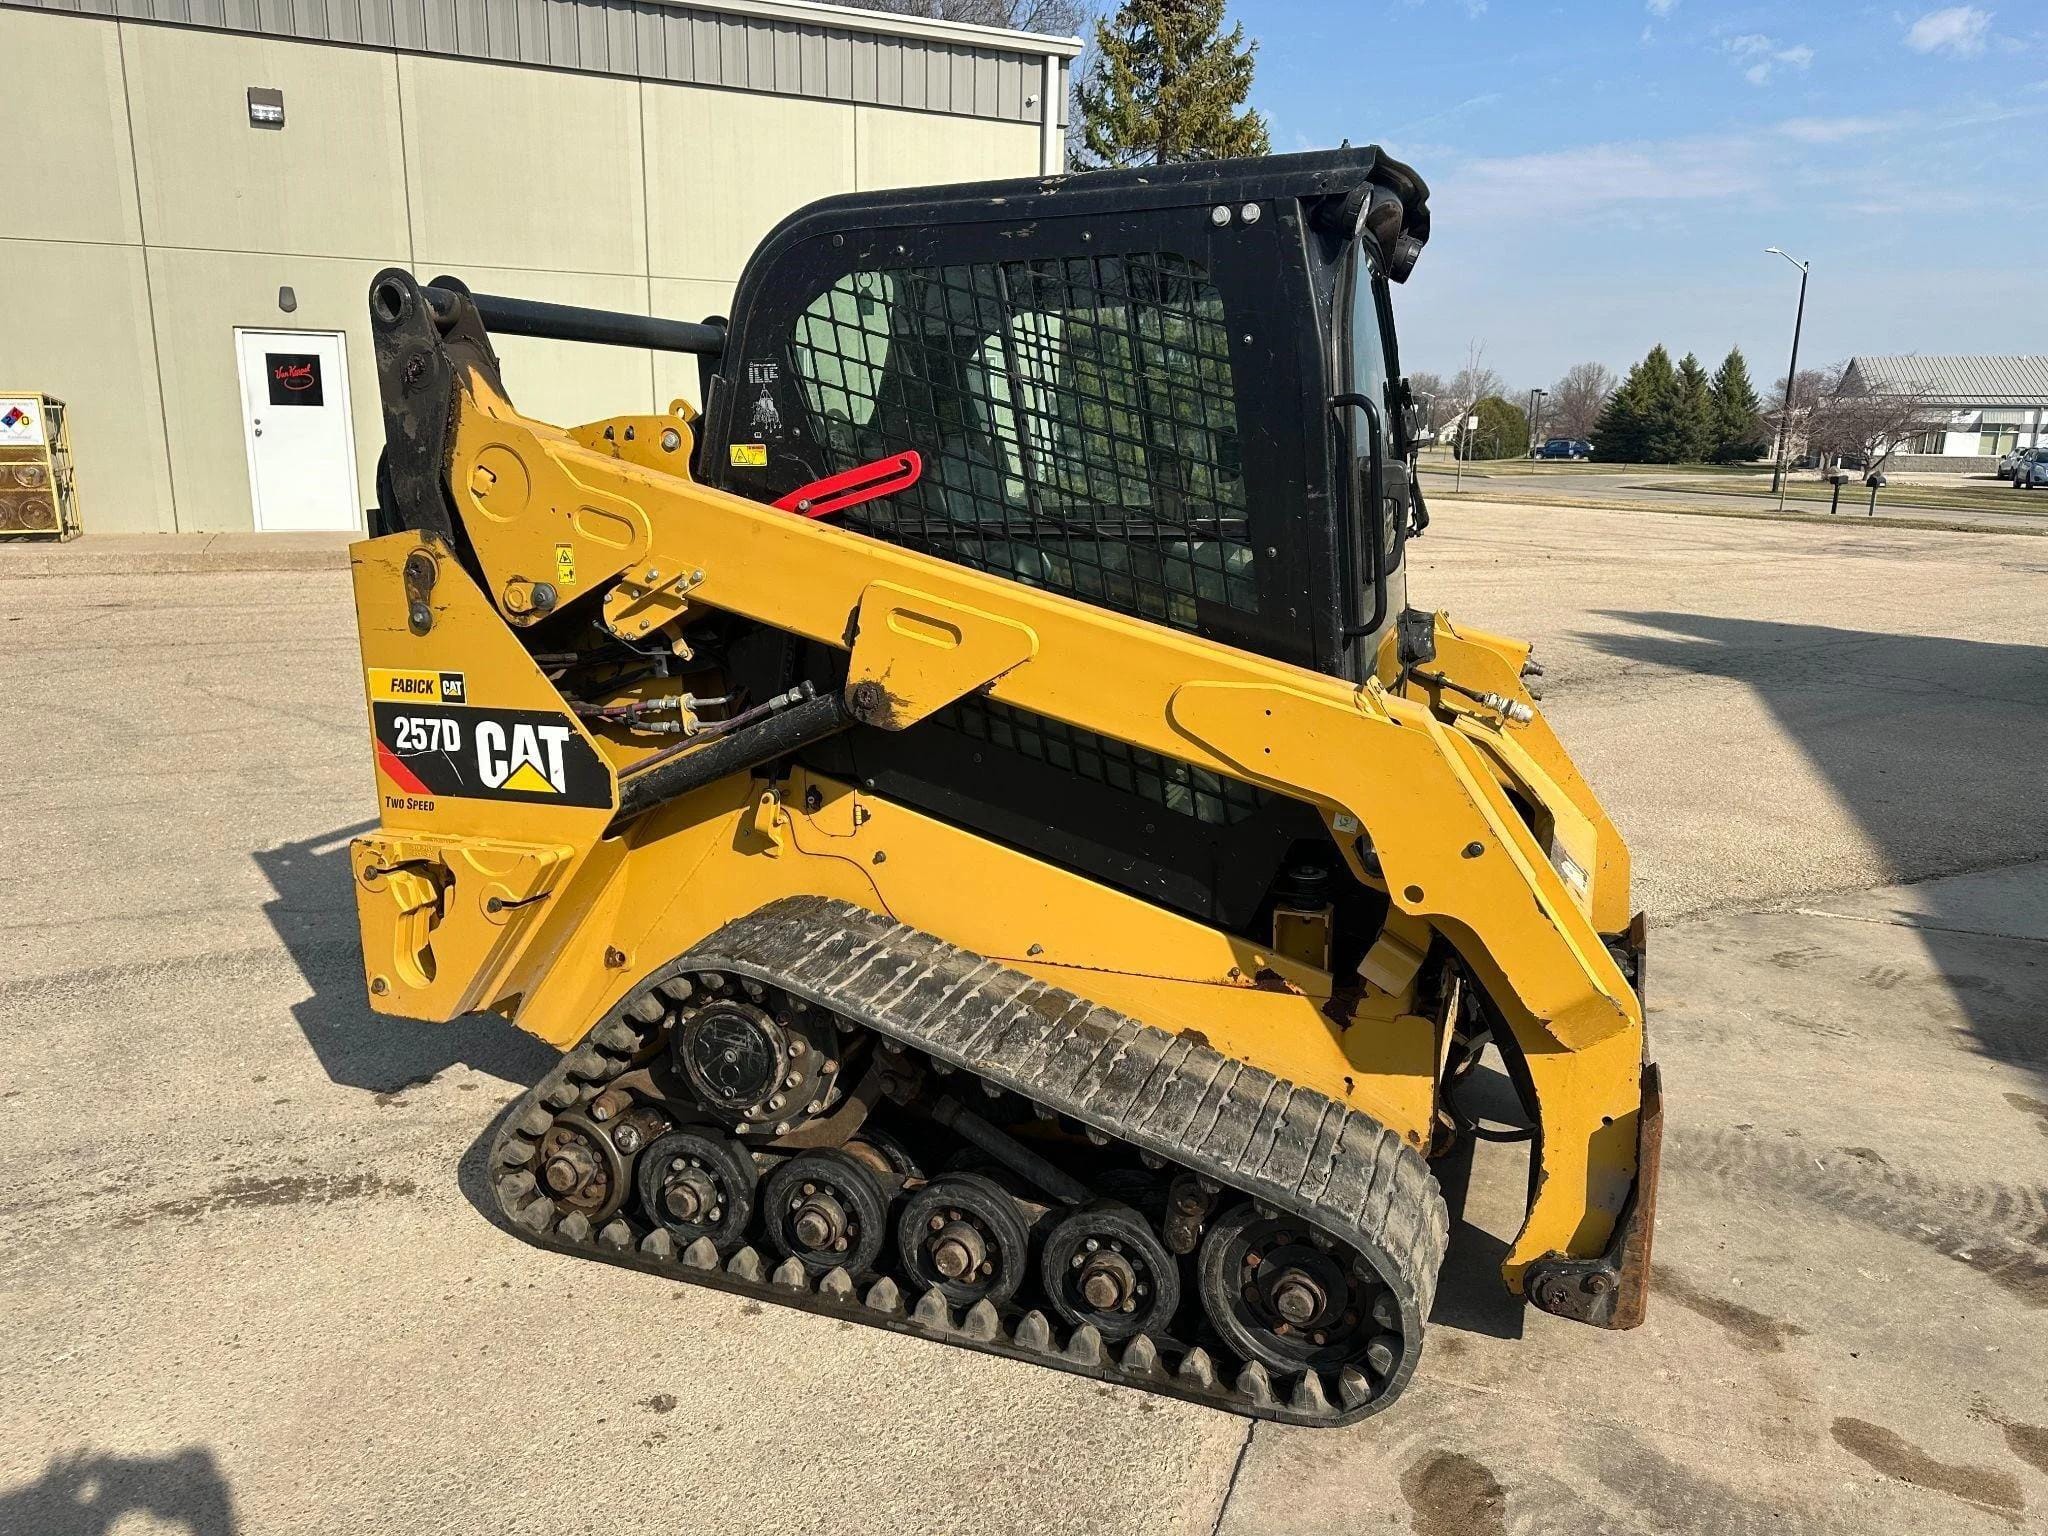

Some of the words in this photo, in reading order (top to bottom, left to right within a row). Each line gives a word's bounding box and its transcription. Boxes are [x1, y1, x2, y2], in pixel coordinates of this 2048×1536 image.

[21, 415, 30, 426] 0
[390, 678, 434, 695] FABICK
[442, 680, 463, 696] CAT
[393, 716, 461, 752] 257D
[474, 720, 570, 794] CAT
